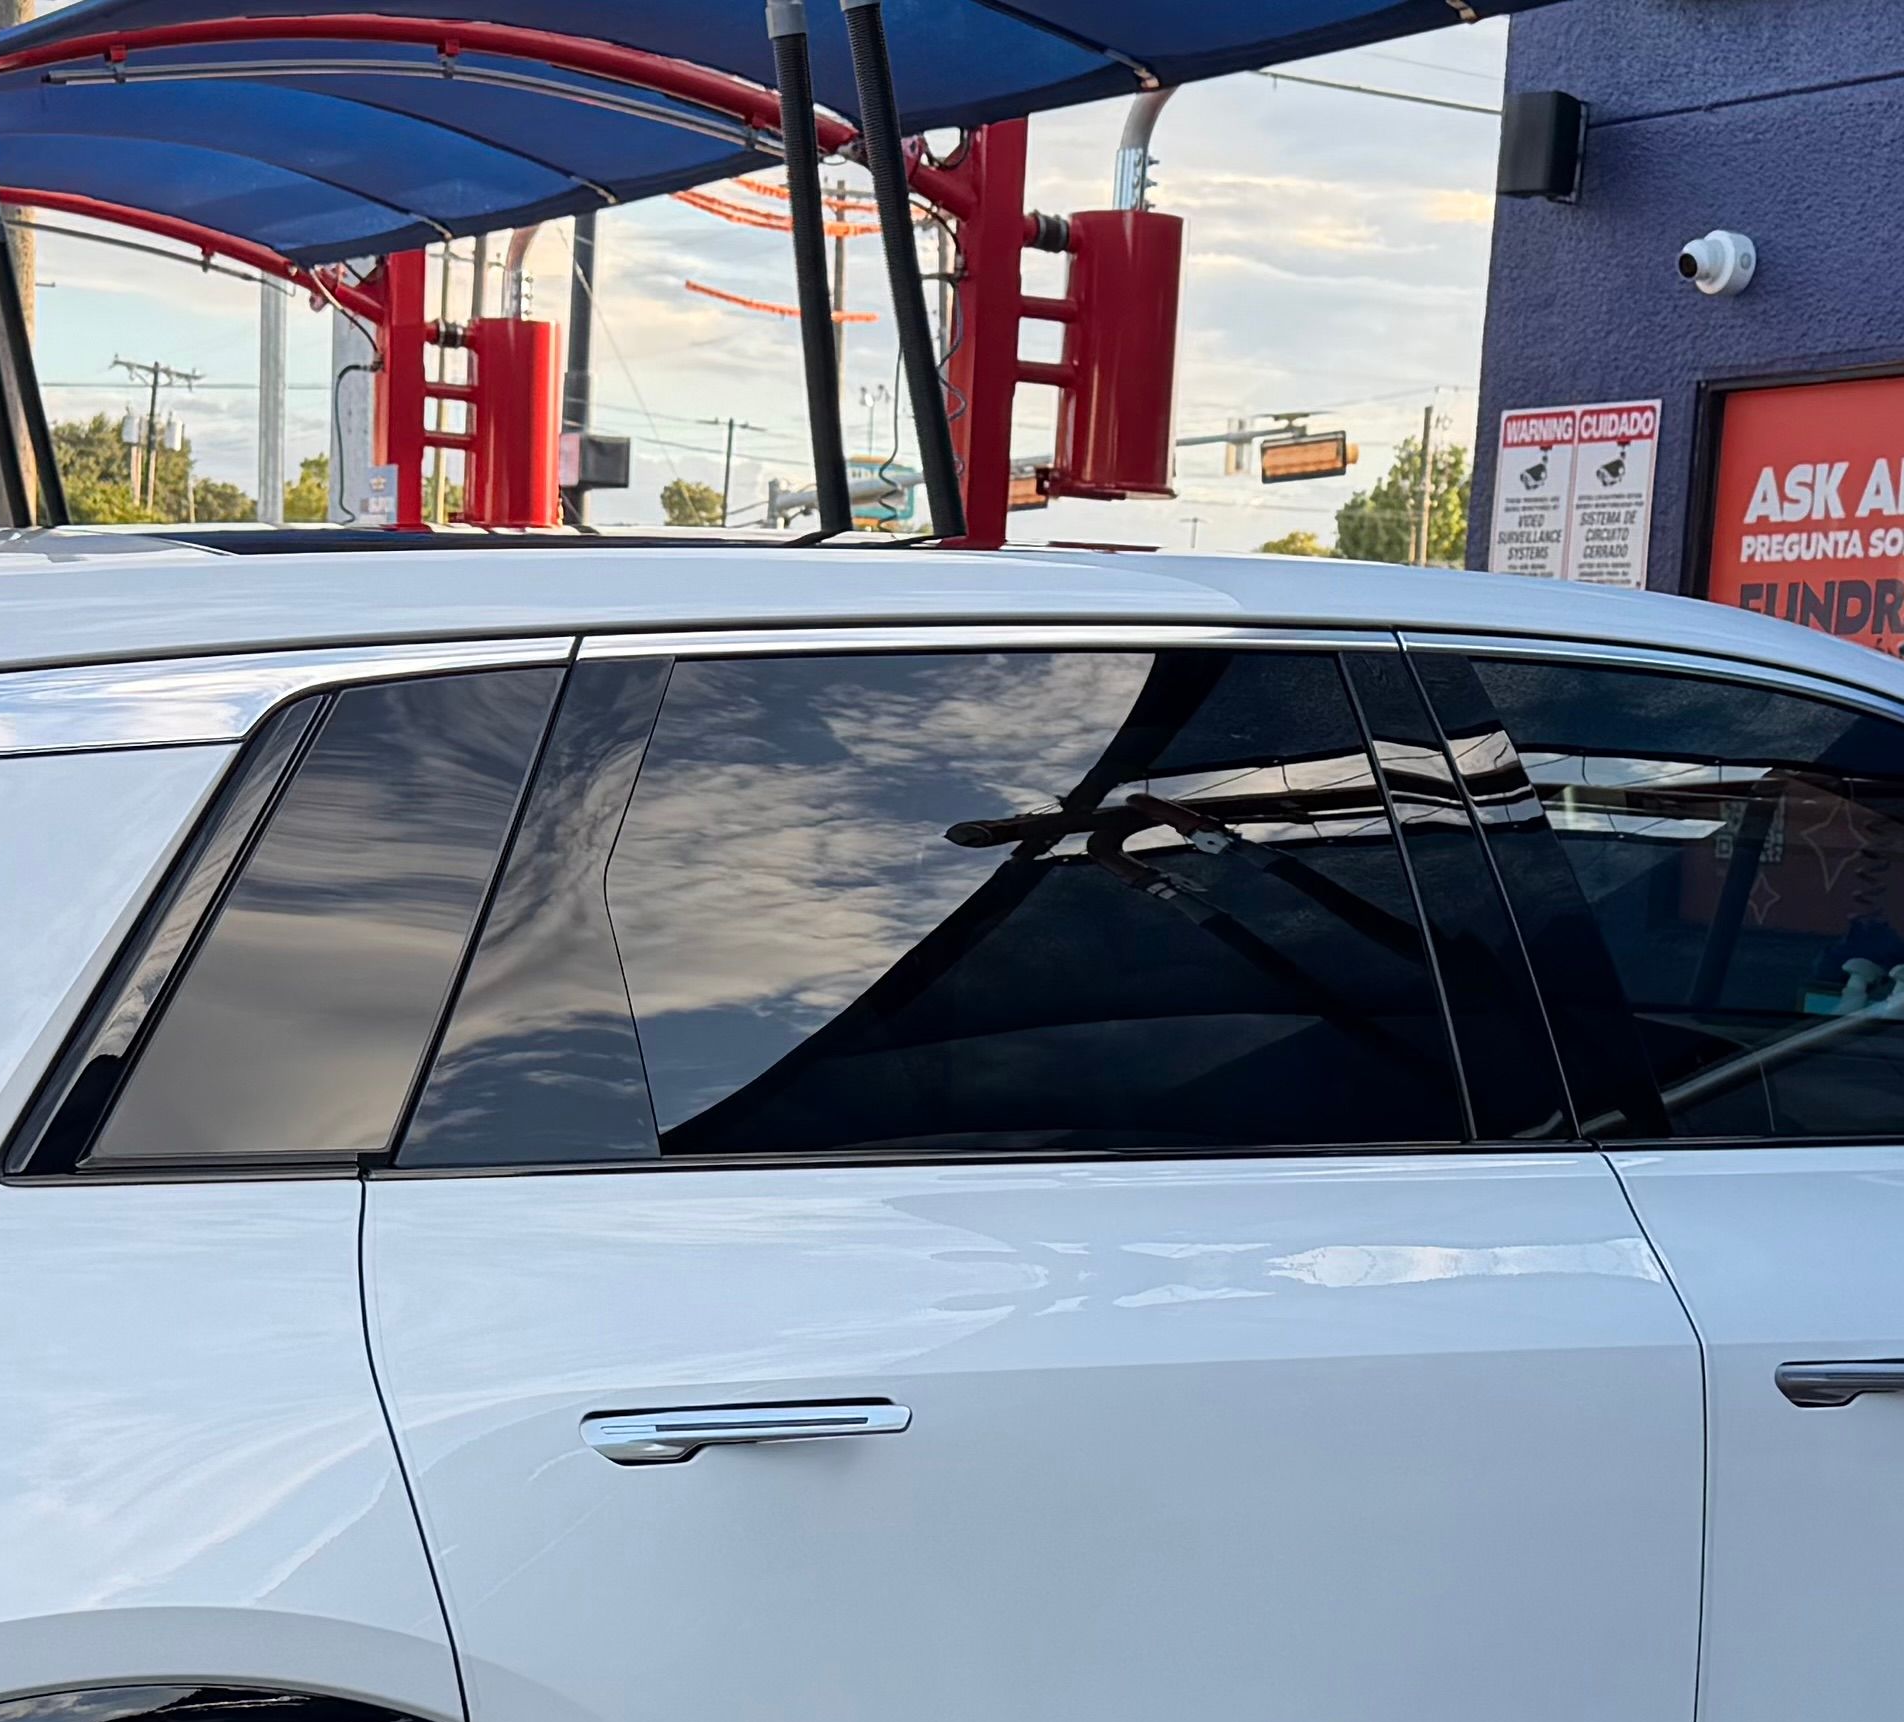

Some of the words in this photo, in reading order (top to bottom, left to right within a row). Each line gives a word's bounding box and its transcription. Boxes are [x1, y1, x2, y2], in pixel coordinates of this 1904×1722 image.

[1505, 416, 1573, 444] WARNING
[1580, 410, 1654, 439] CUIDADO
[1743, 461, 1850, 524] ASK
[1623, 510, 1637, 525] DE
[1740, 529, 1864, 563] PREGUNTA
